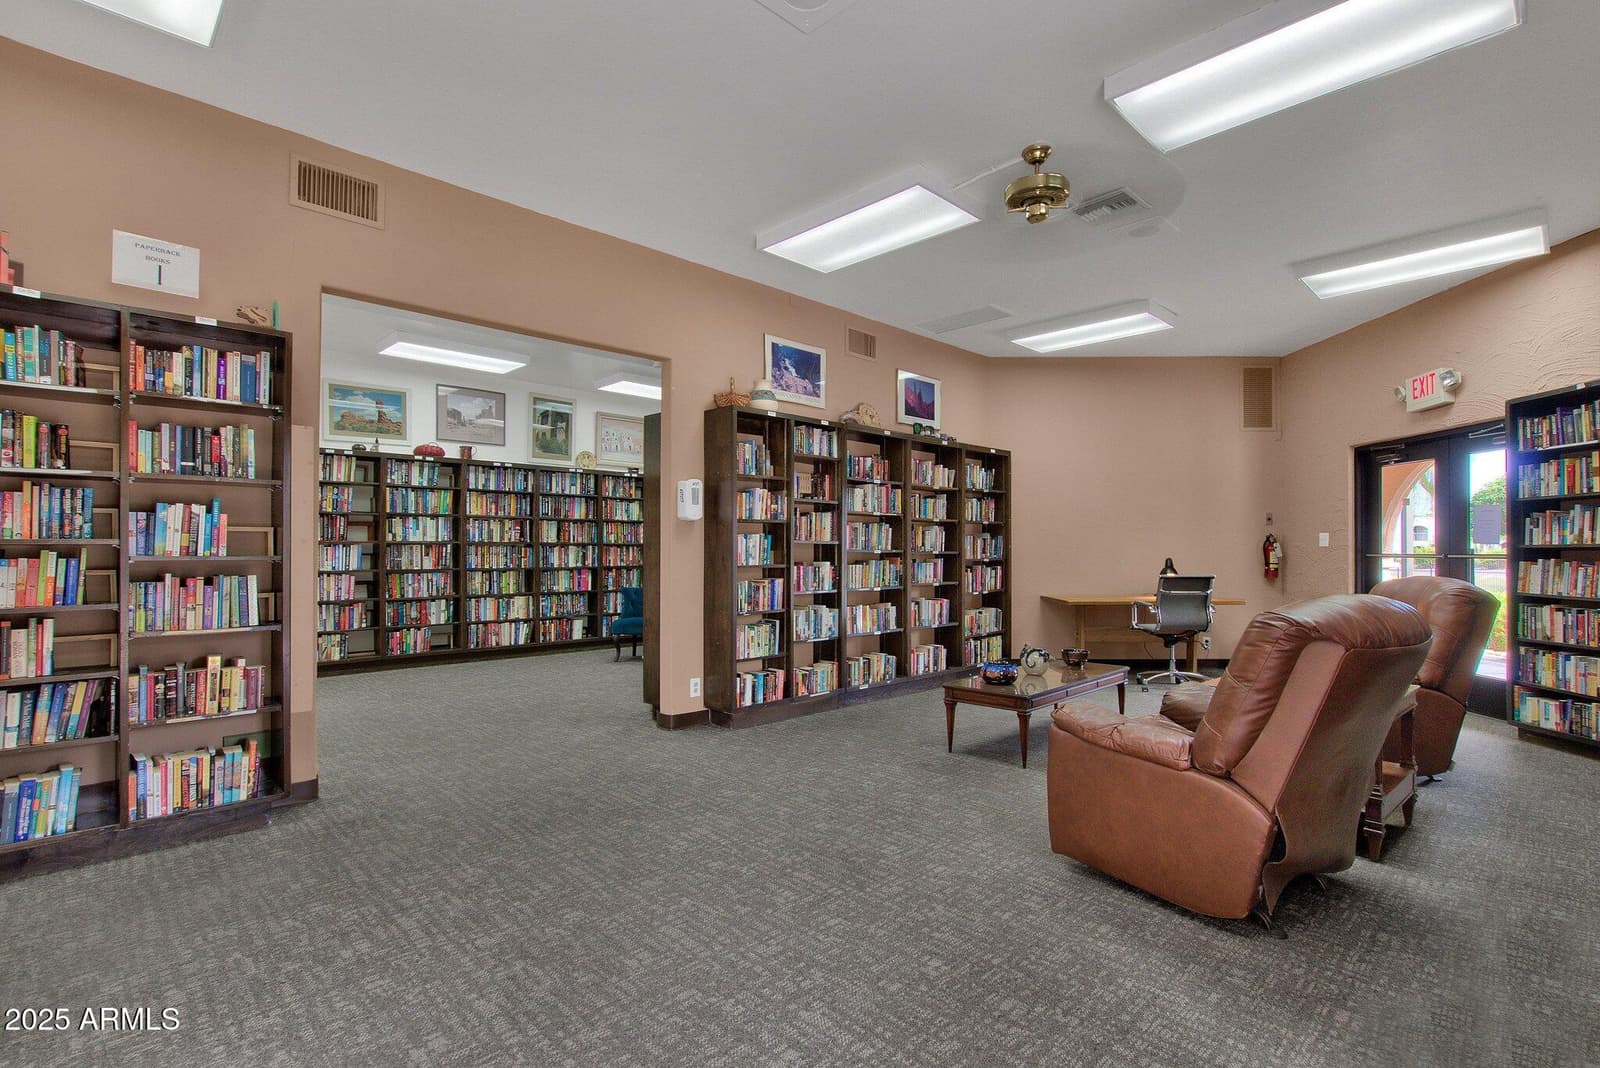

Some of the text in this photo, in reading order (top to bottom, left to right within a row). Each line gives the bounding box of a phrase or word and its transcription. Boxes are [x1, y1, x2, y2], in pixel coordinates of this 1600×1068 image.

[134, 242, 181, 257] PAPERBACK
[145, 255, 171, 265] BOOKS
[1411, 372, 1436, 400] EXIT
